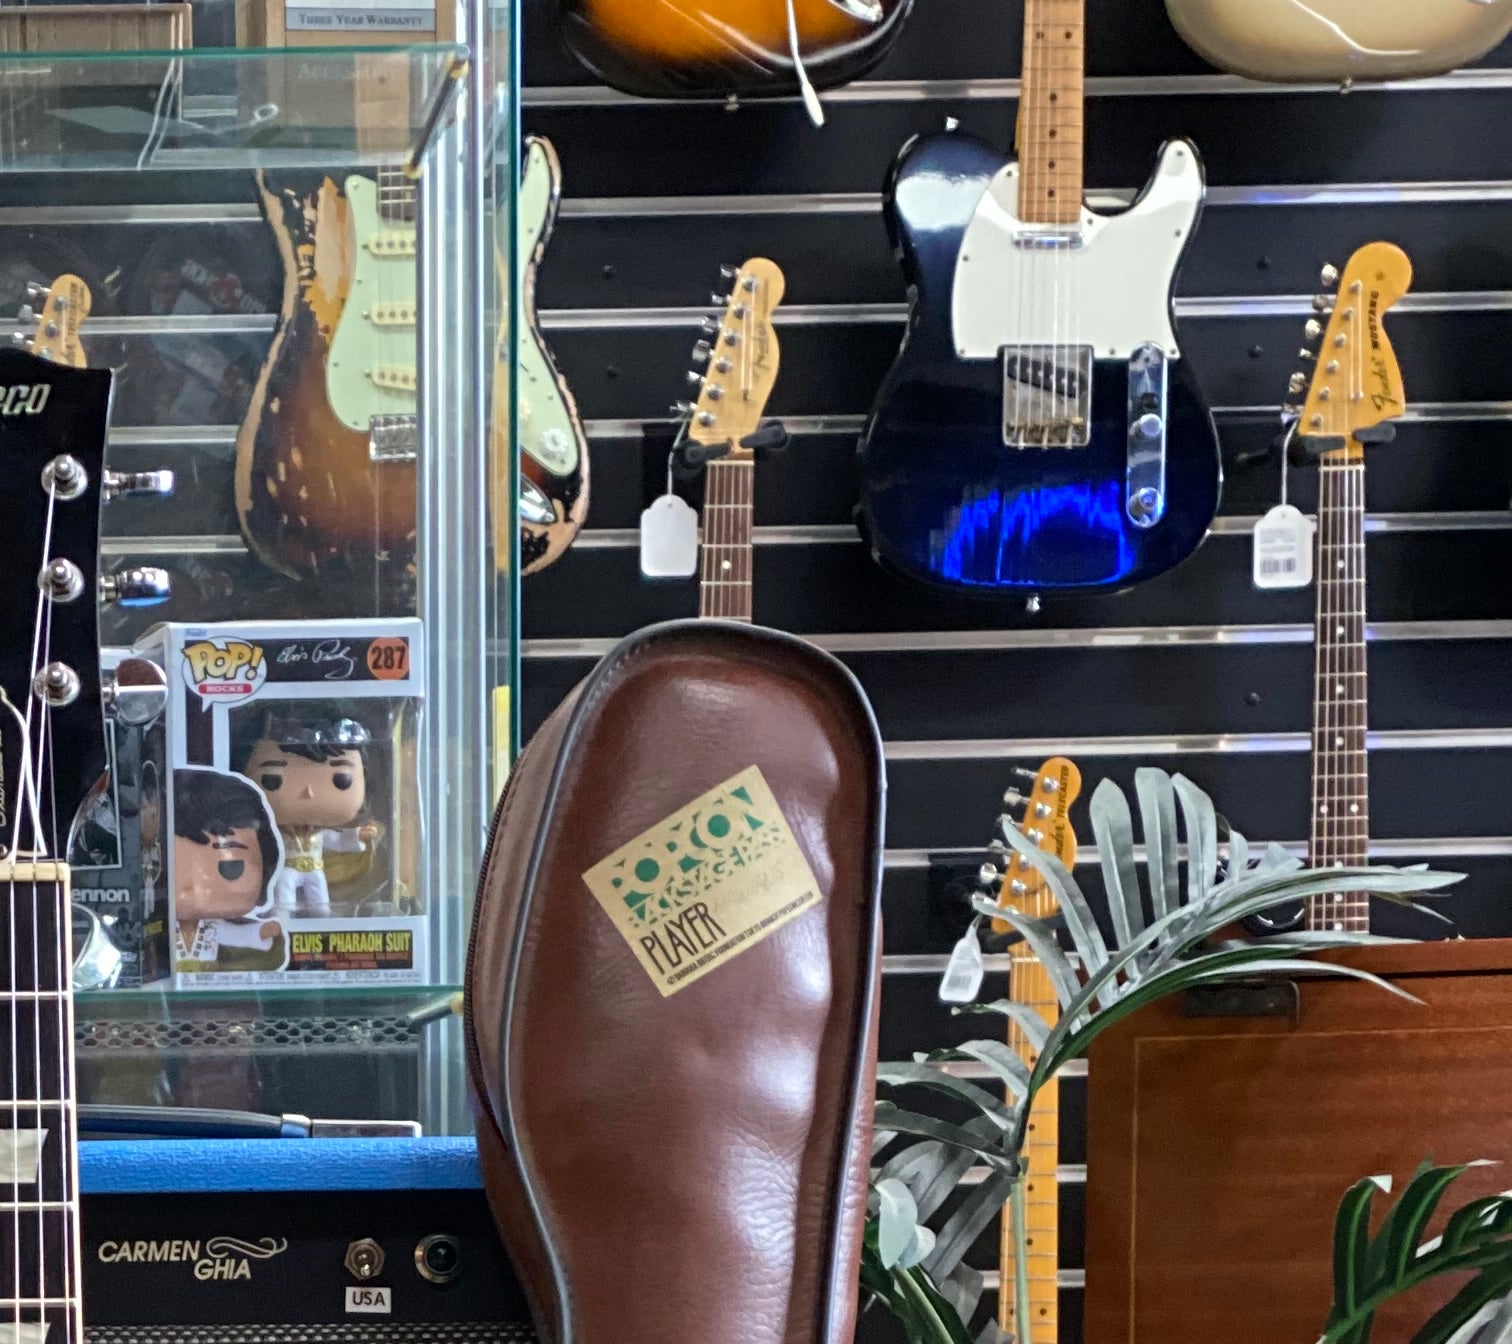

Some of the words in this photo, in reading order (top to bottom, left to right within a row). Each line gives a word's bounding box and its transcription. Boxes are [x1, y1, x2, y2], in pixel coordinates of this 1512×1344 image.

[336, 13, 364, 25] YEAR
[366, 14, 423, 25] WARRANTY
[182, 640, 264, 684] POP!
[370, 645, 406, 671] 287
[206, 684, 245, 694] ROCKS
[71, 888, 130, 902] ennon
[291, 932, 323, 954] ELVIS
[328, 932, 383, 954] PHARAOH
[385, 931, 411, 953] SUIT
[640, 901, 728, 976] PLAYER
[98, 1240, 201, 1263] CARMEN
[193, 1258, 252, 1282] GHIA
[351, 1289, 386, 1307] USA
